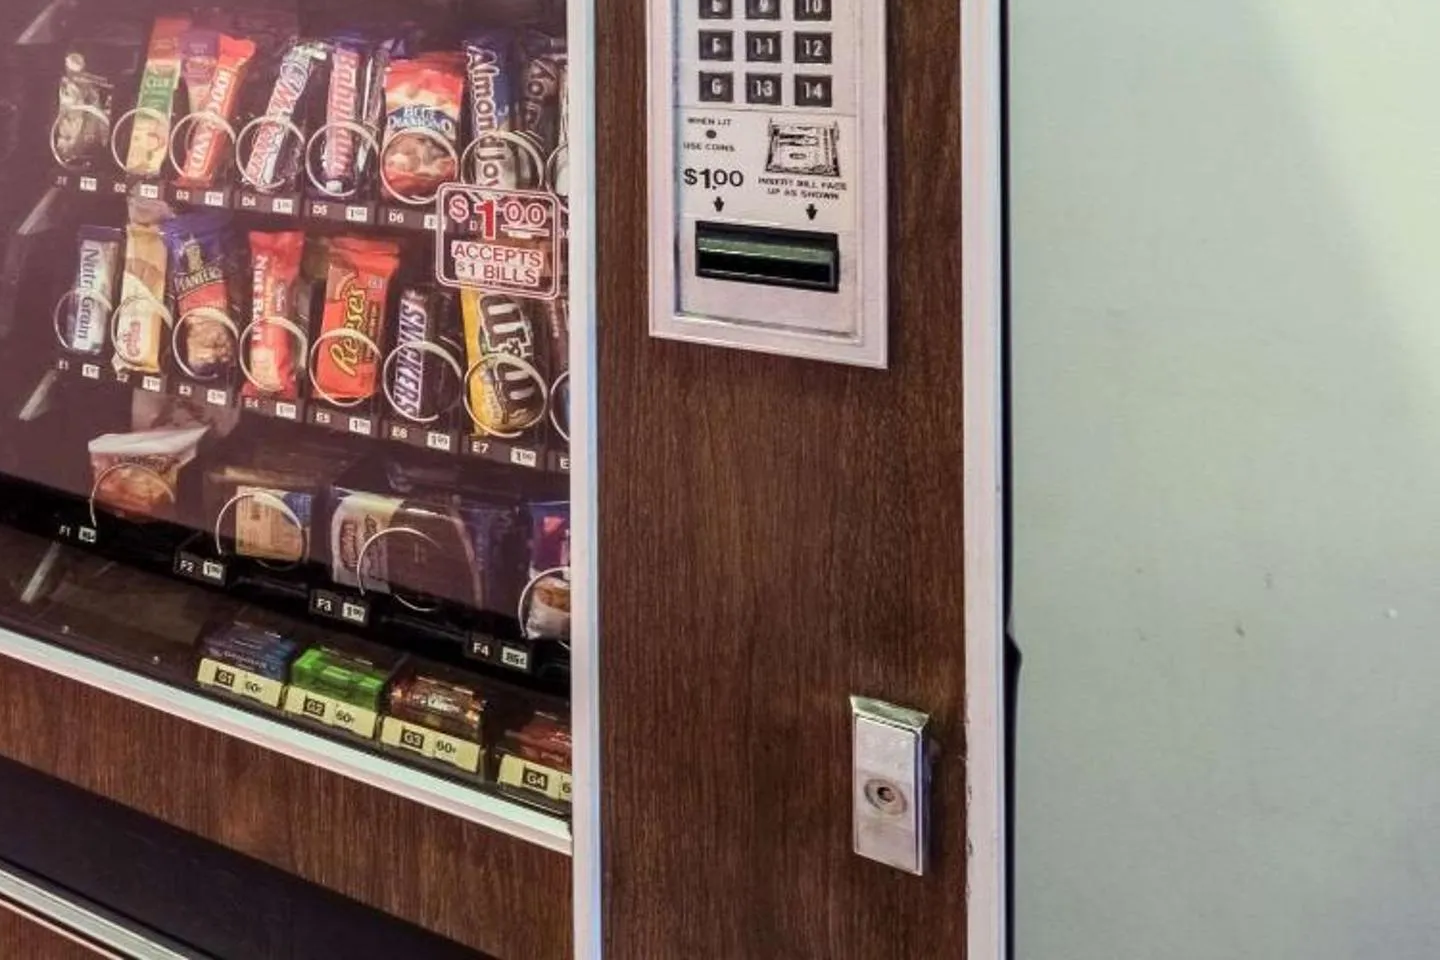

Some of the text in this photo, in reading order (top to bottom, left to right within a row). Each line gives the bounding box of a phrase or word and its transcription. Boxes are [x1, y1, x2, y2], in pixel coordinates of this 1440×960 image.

[712, 38, 721, 53] F
[754, 38, 774, 55] 11
[804, 39, 824, 57] 12
[711, 81, 722, 96] G
[754, 79, 774, 97] 13
[804, 81, 824, 99] 14
[687, 116, 732, 127] WHEN LIT
[683, 142, 736, 153] USE COINS
[758, 176, 794, 187] INSERT
[821, 181, 848, 191] FACE
[800, 190, 840, 201] SHOWN
[454, 243, 542, 268] ACCEPTS
[483, 263, 537, 285] BILLS
[472, 442, 489, 455] E7
[59, 525, 72, 537] F1
[180, 559, 194, 572] F2
[317, 598, 332, 612] F3
[473, 642, 489, 657] F4
[216, 670, 234, 685] G1
[306, 701, 325, 716] G2
[402, 731, 423, 746] G3
[526, 771, 547, 787] G4
